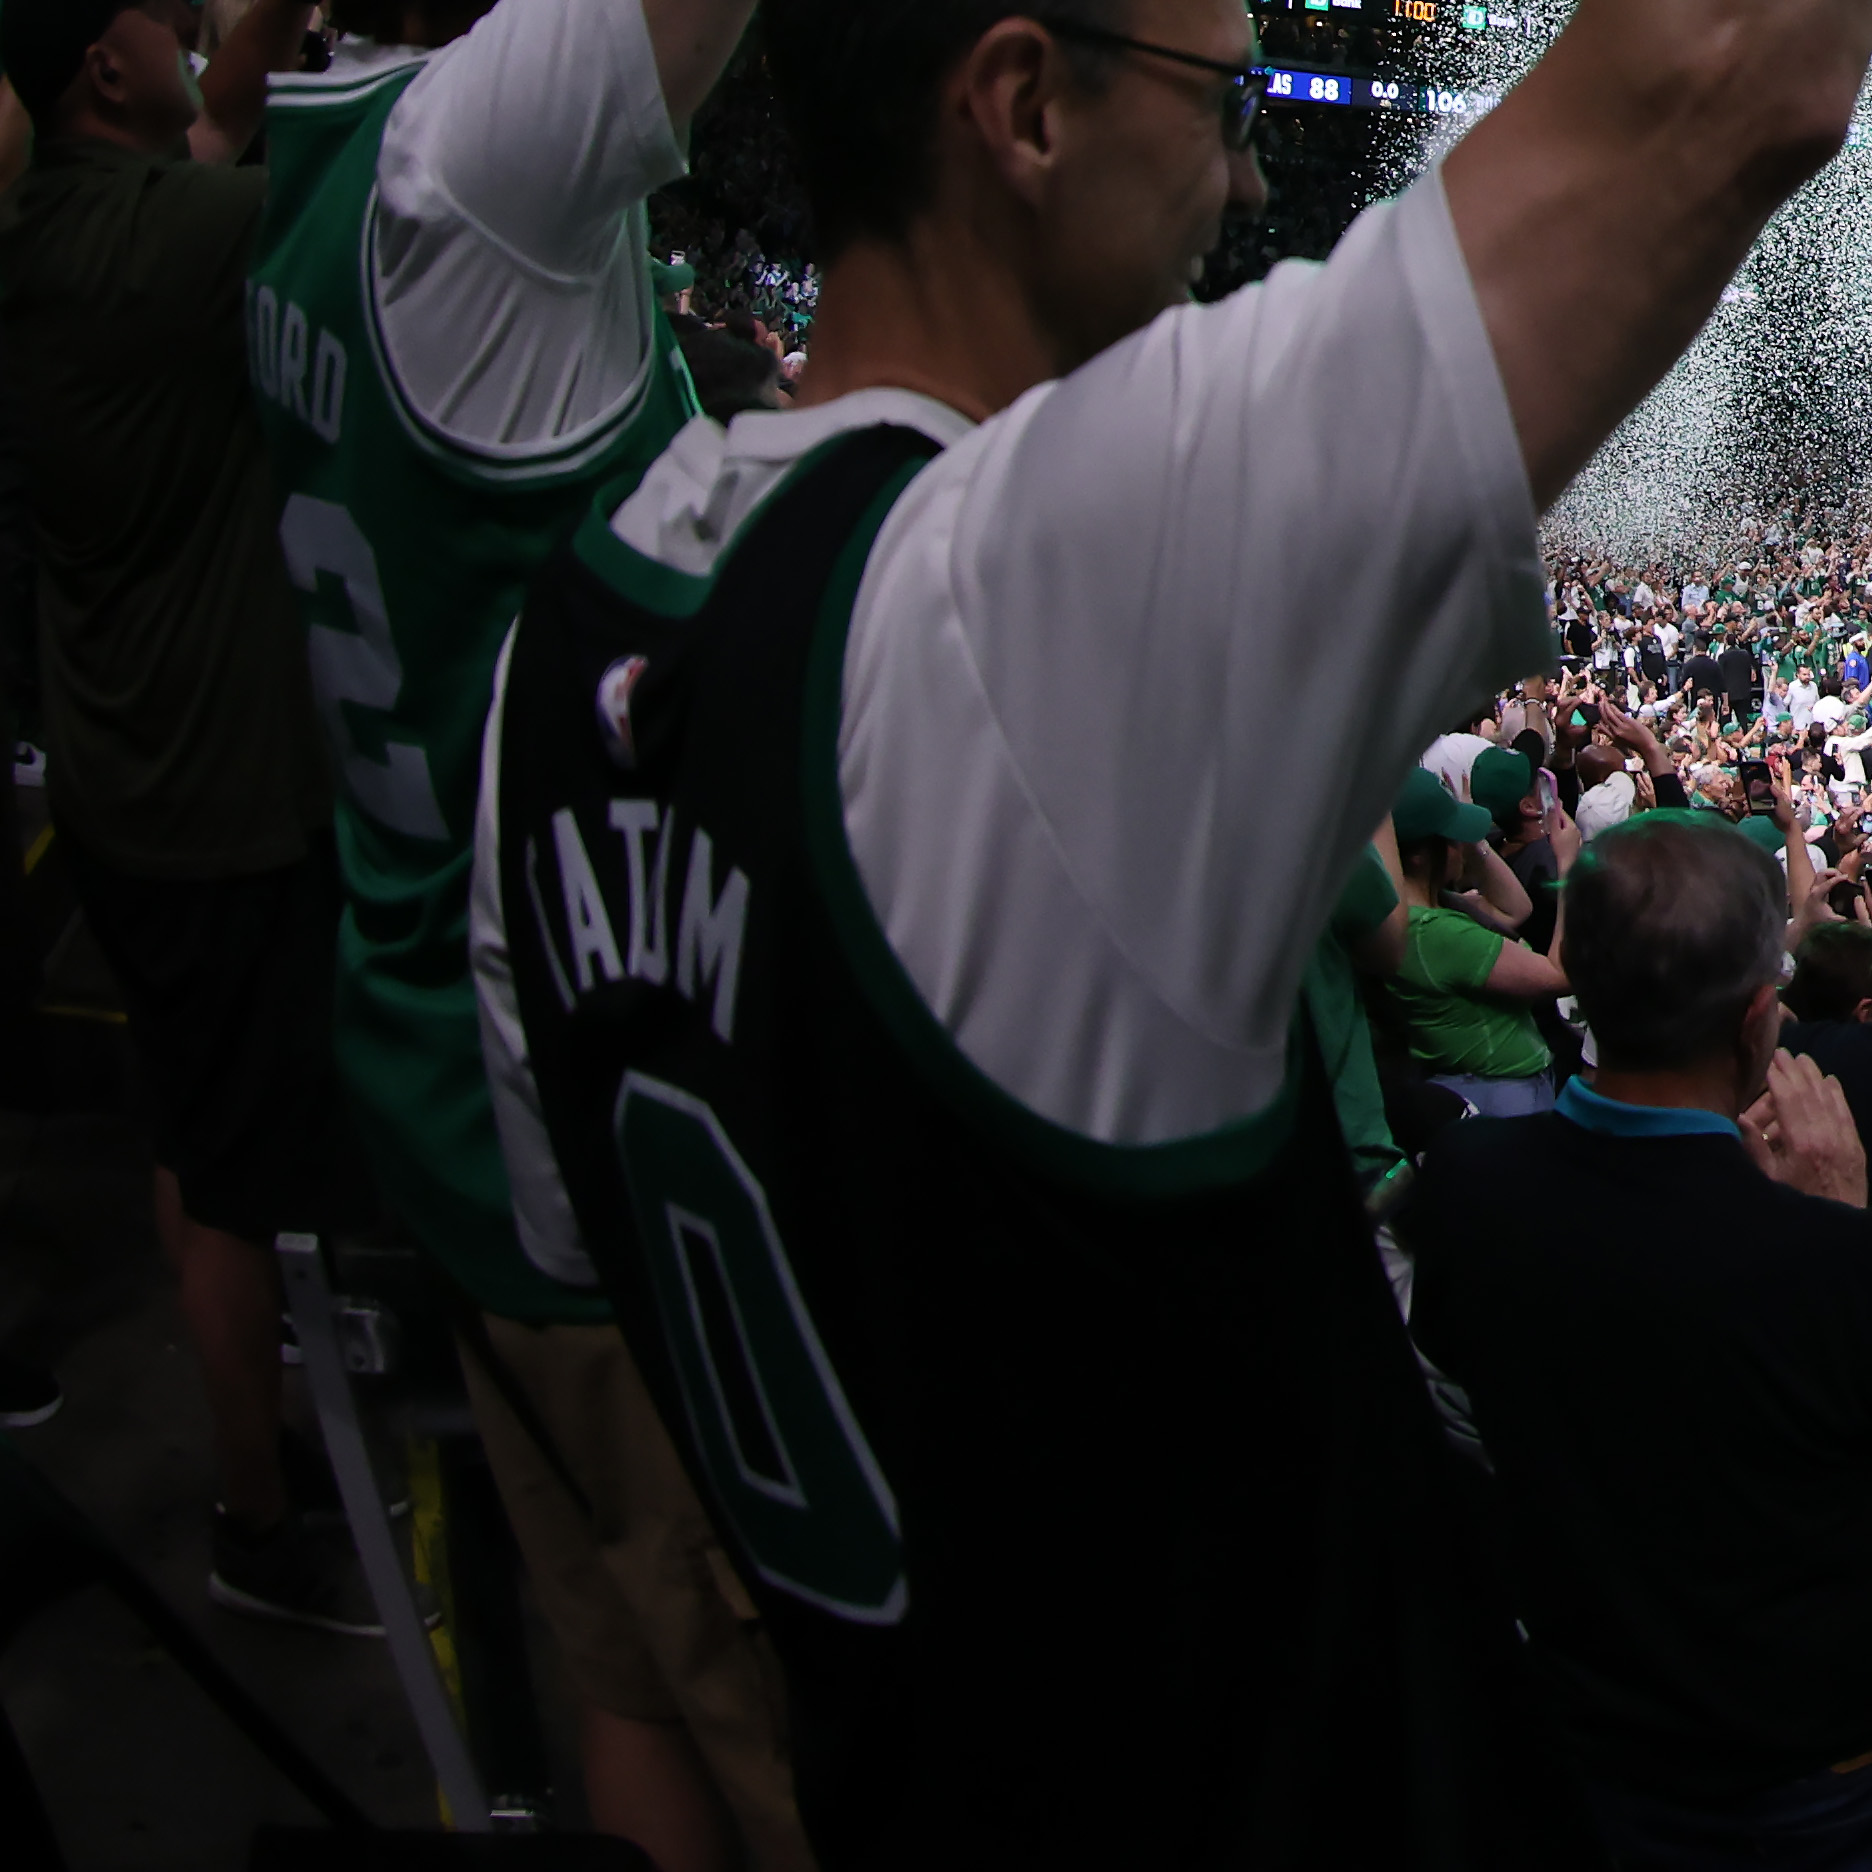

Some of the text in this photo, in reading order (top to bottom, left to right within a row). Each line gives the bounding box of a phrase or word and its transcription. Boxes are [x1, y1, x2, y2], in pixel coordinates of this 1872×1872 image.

[1308, 77, 1339, 102] 88
[1370, 80, 1400, 99] 0.0
[1426, 88, 1467, 114] 106
[246, 278, 349, 447] ORD
[279, 494, 450, 842] 2
[615, 1068, 910, 1626] 0
